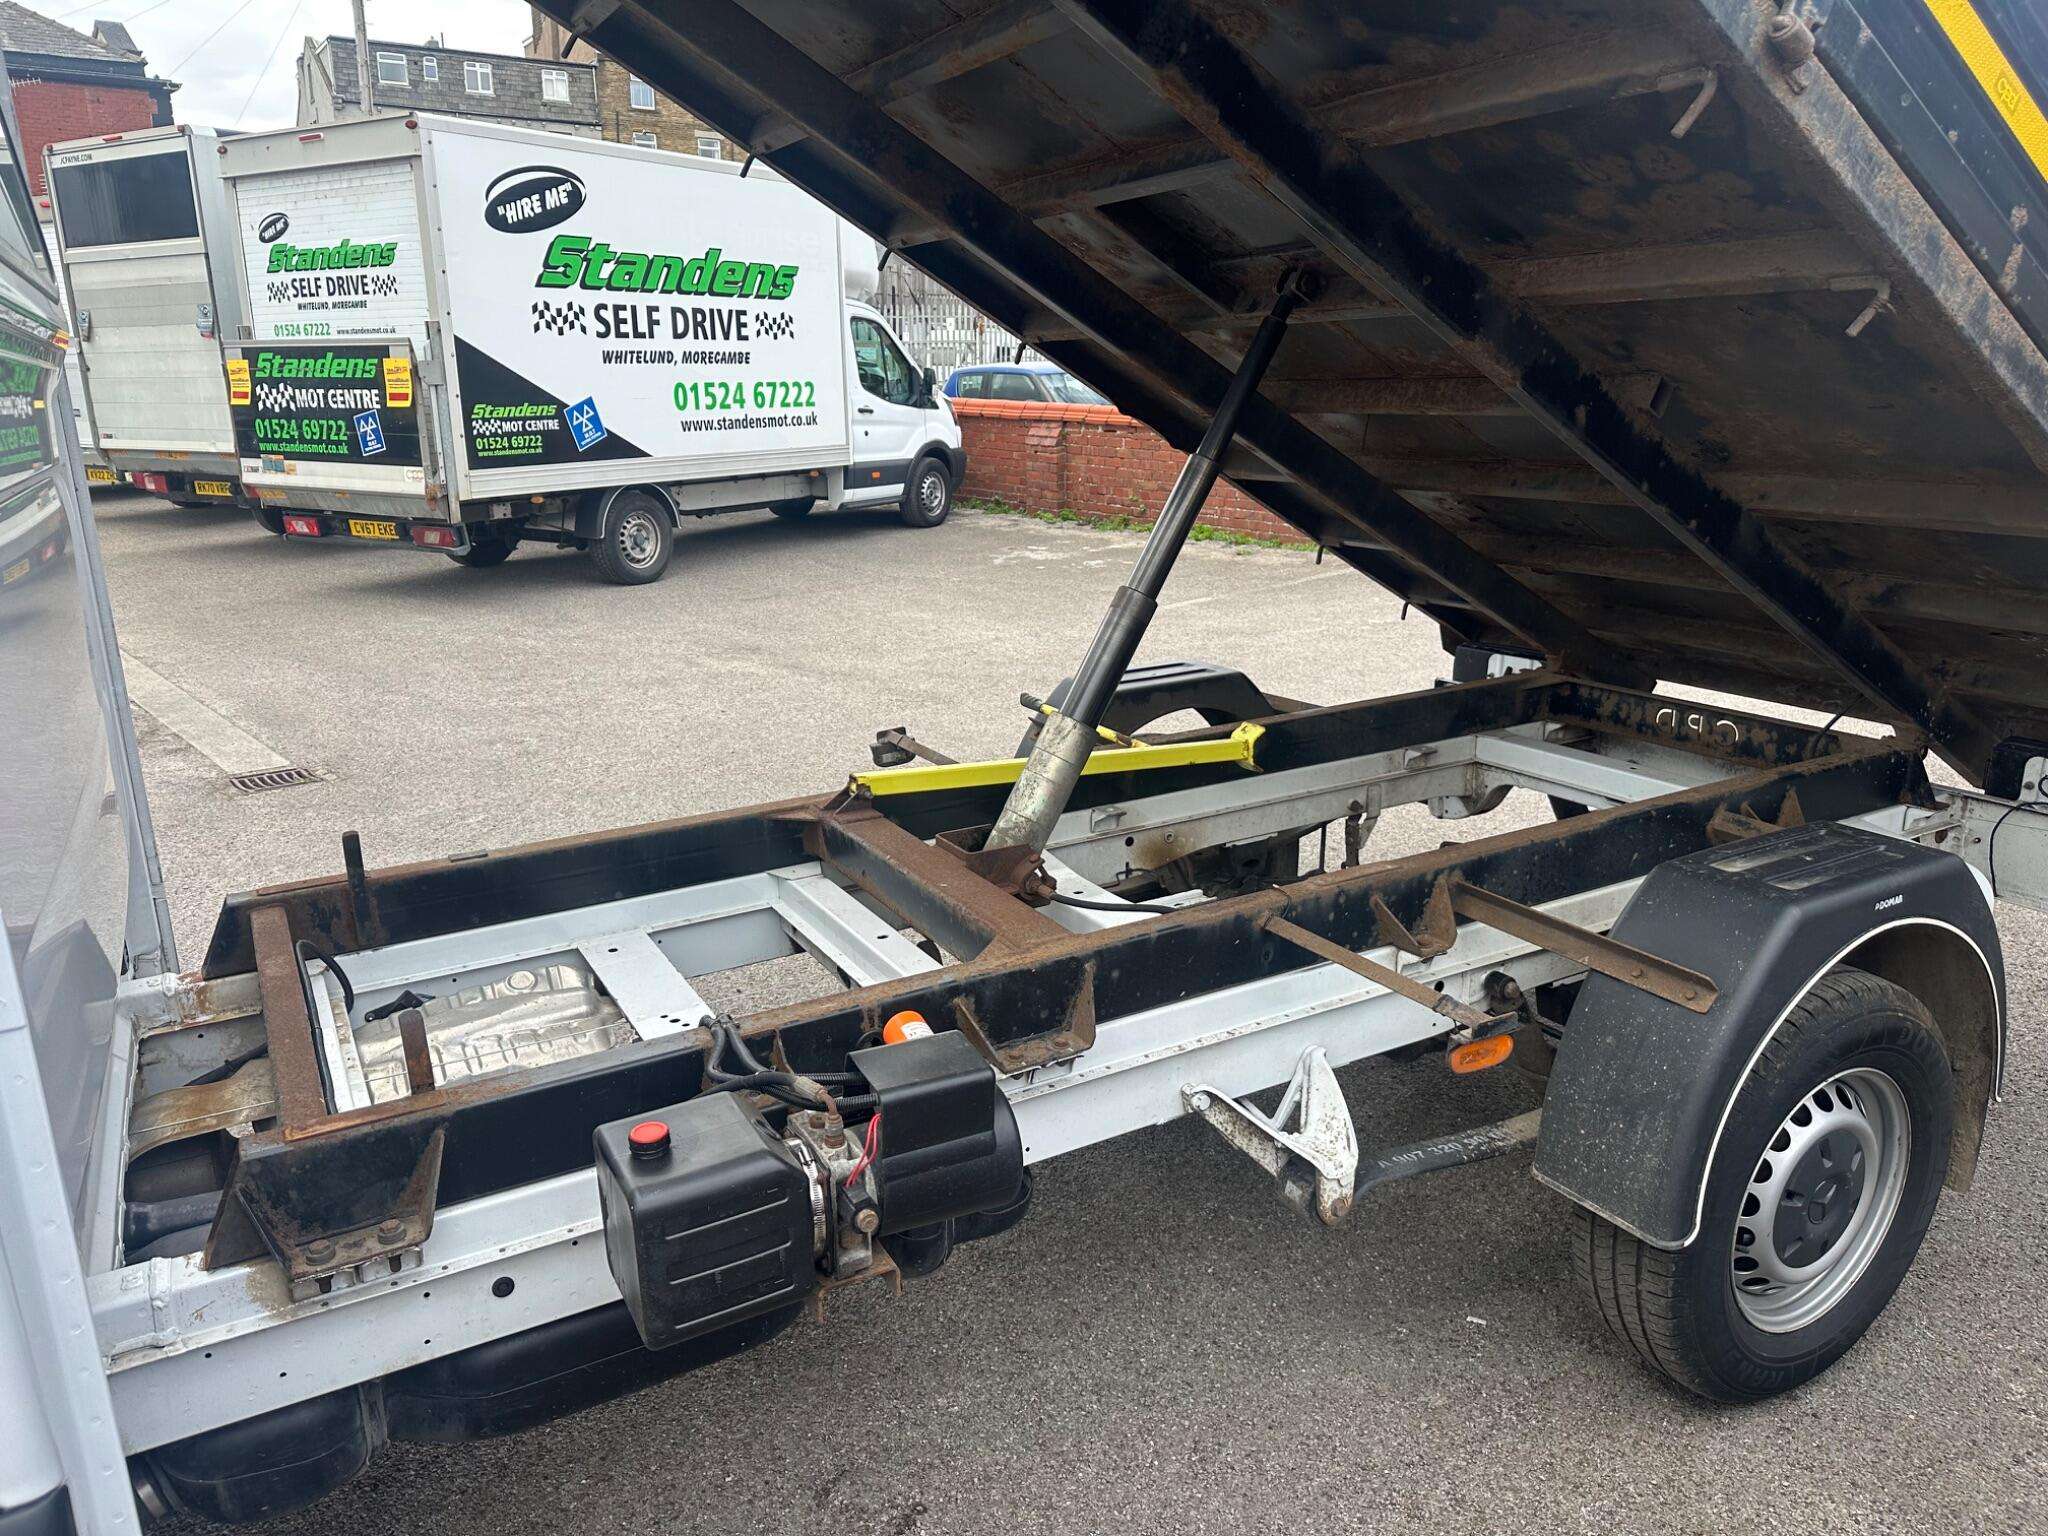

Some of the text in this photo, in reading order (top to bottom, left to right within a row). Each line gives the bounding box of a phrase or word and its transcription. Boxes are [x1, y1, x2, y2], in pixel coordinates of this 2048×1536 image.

[266, 238, 398, 273] Standens
[535, 234, 799, 300] Standens
[290, 274, 371, 298] SELF DRIVE
[273, 323, 331, 337] 01524 67222
[336, 327, 397, 336] www.standensmot.co.uk
[593, 303, 749, 341] SELF DRIVE
[255, 352, 379, 378] Standens
[602, 350, 751, 366] WHITELUND, MORECAMBE
[294, 388, 381, 410] MOT CENTRE
[673, 381, 816, 411] 01524 67222
[471, 402, 557, 419] Standens
[255, 418, 349, 441] 01524 69722
[501, 419, 560, 433] MOT CENTRE
[680, 411, 819, 432] www.standensmot.co.uk
[258, 441, 349, 455] www.standensmot.co.uk
[475, 435, 543, 450] 01524 69722
[477, 447, 543, 457] www.standensmot.co.uk
[353, 521, 376, 535] CV67
